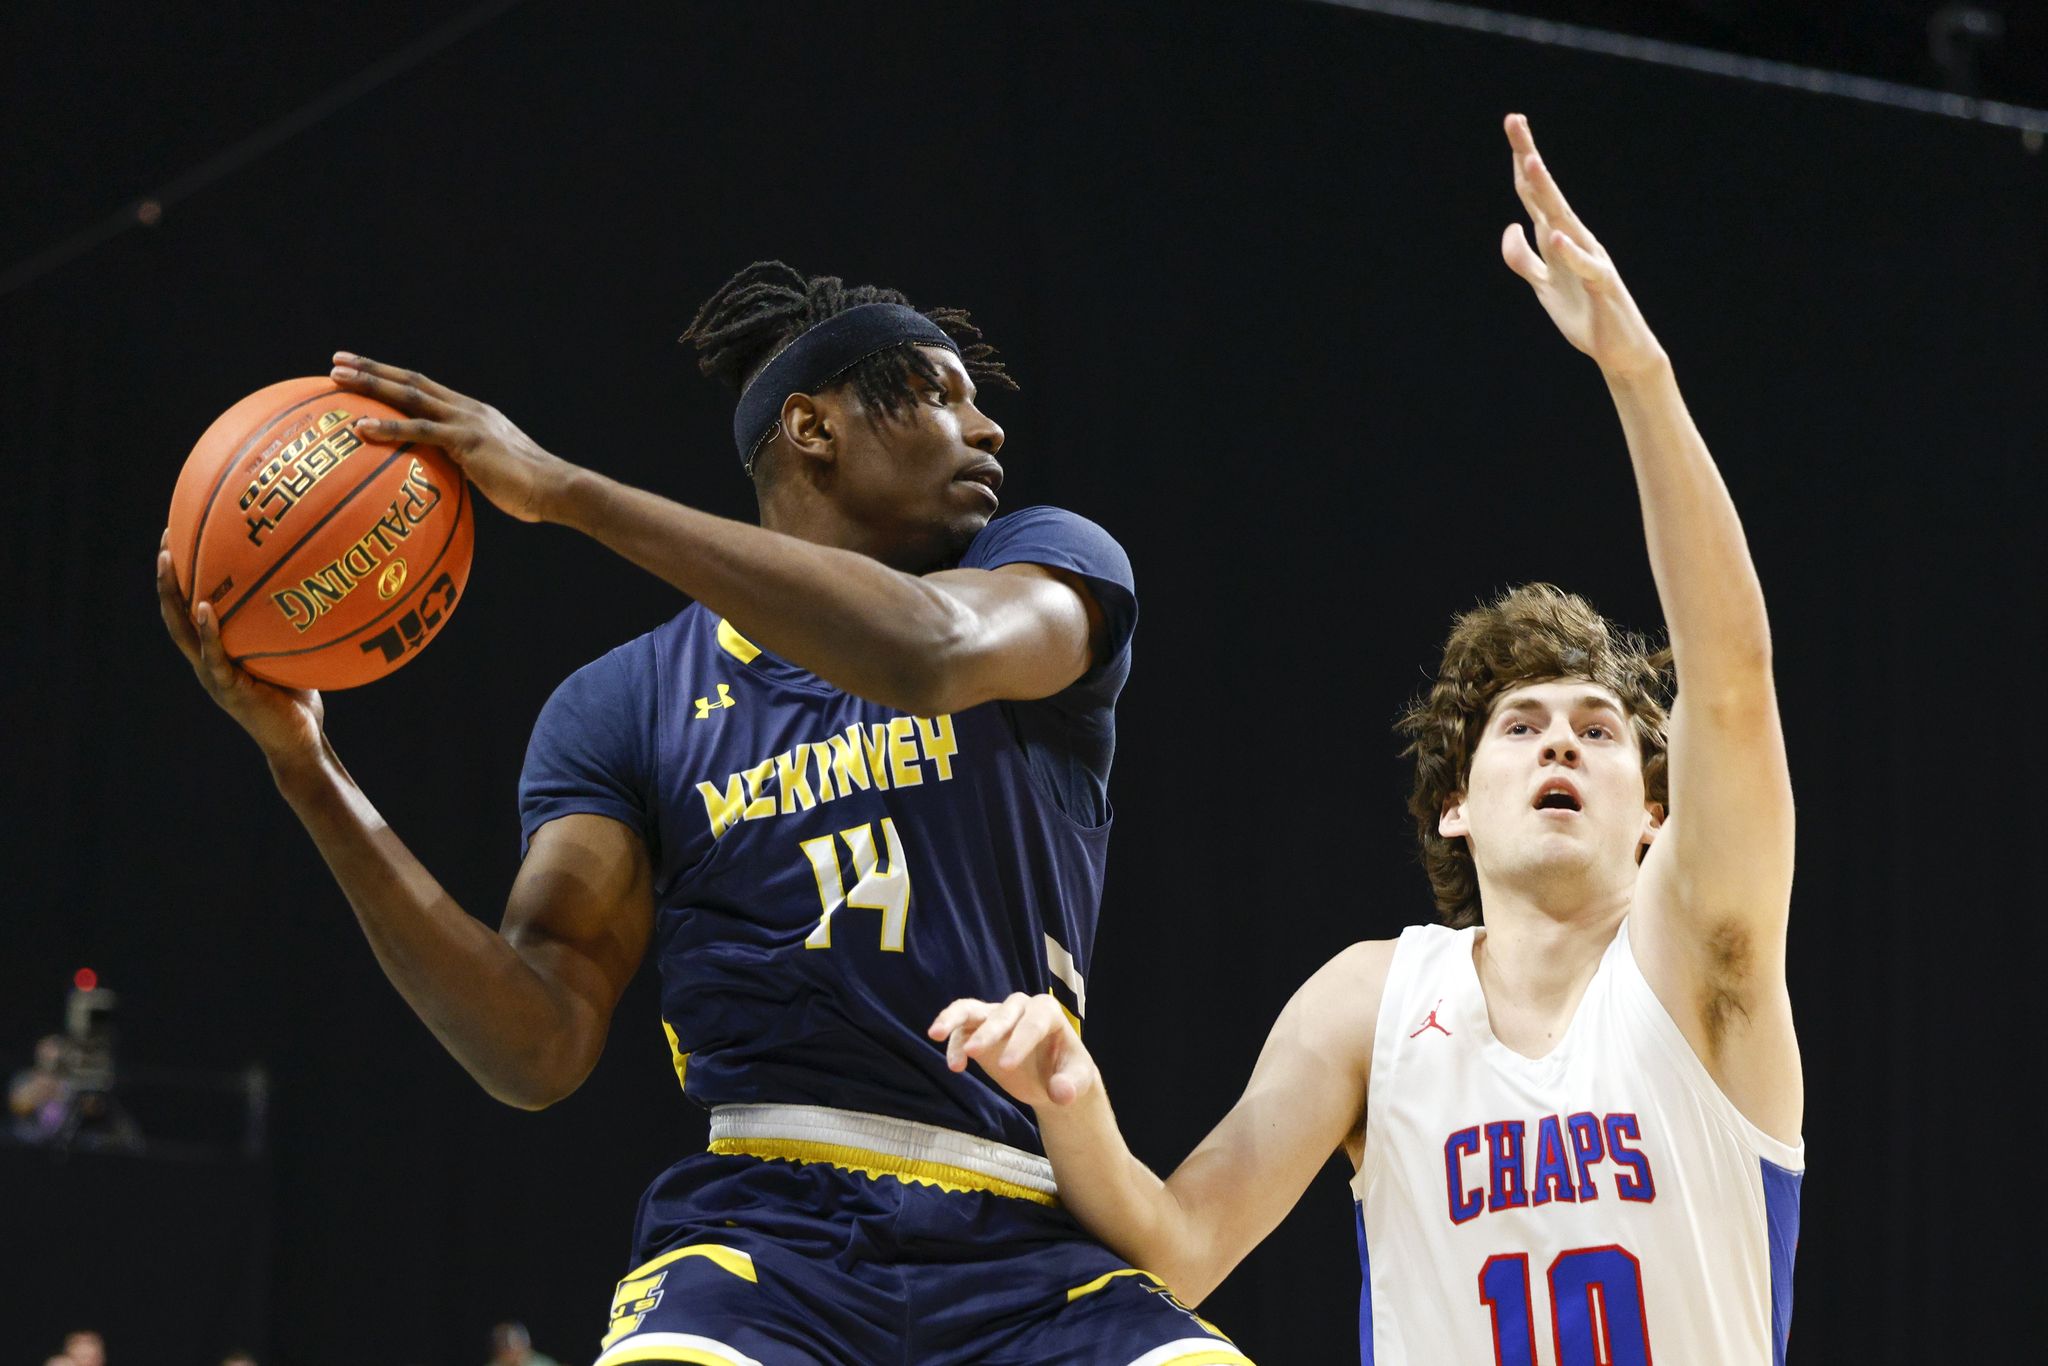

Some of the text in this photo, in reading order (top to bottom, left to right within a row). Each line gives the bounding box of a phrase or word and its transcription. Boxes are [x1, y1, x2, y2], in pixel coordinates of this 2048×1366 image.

[247, 415, 366, 547] EGACY
[271, 457, 442, 633] SPALDING
[799, 817, 911, 953] 14
[1444, 1111, 1656, 1226] CHAPS
[1478, 1244, 1653, 1366] 10
